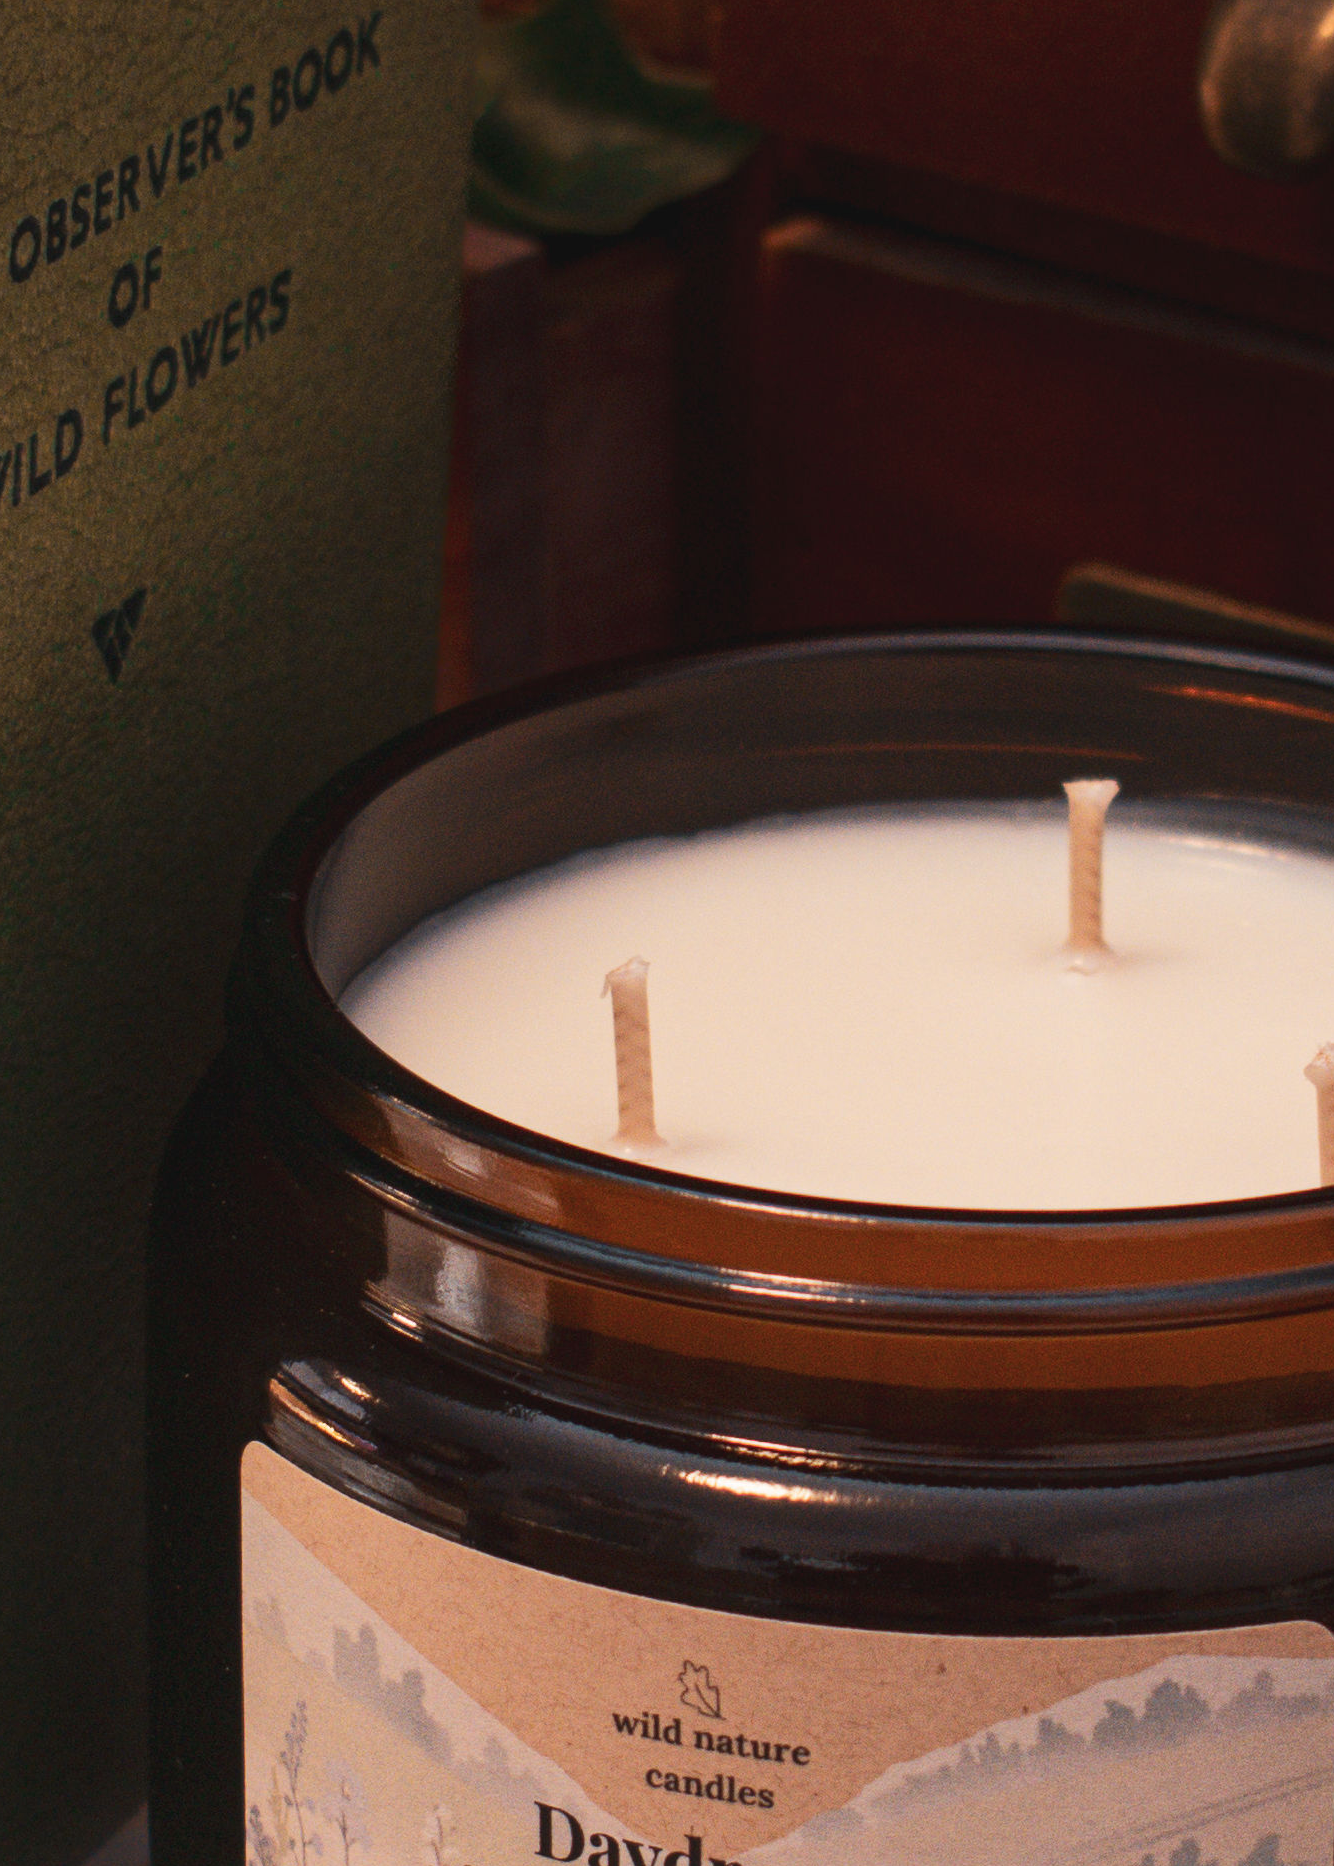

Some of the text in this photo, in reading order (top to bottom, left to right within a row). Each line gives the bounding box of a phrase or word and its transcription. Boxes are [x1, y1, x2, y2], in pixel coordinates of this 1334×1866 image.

[8, 84, 255, 283] OBSERVER'S
[269, 11, 383, 128] BOOK
[107, 245, 163, 329] OF
[102, 269, 293, 445] FLOWERS
[612, 1708, 811, 1767] wild nature
[645, 1762, 774, 1809] candles
